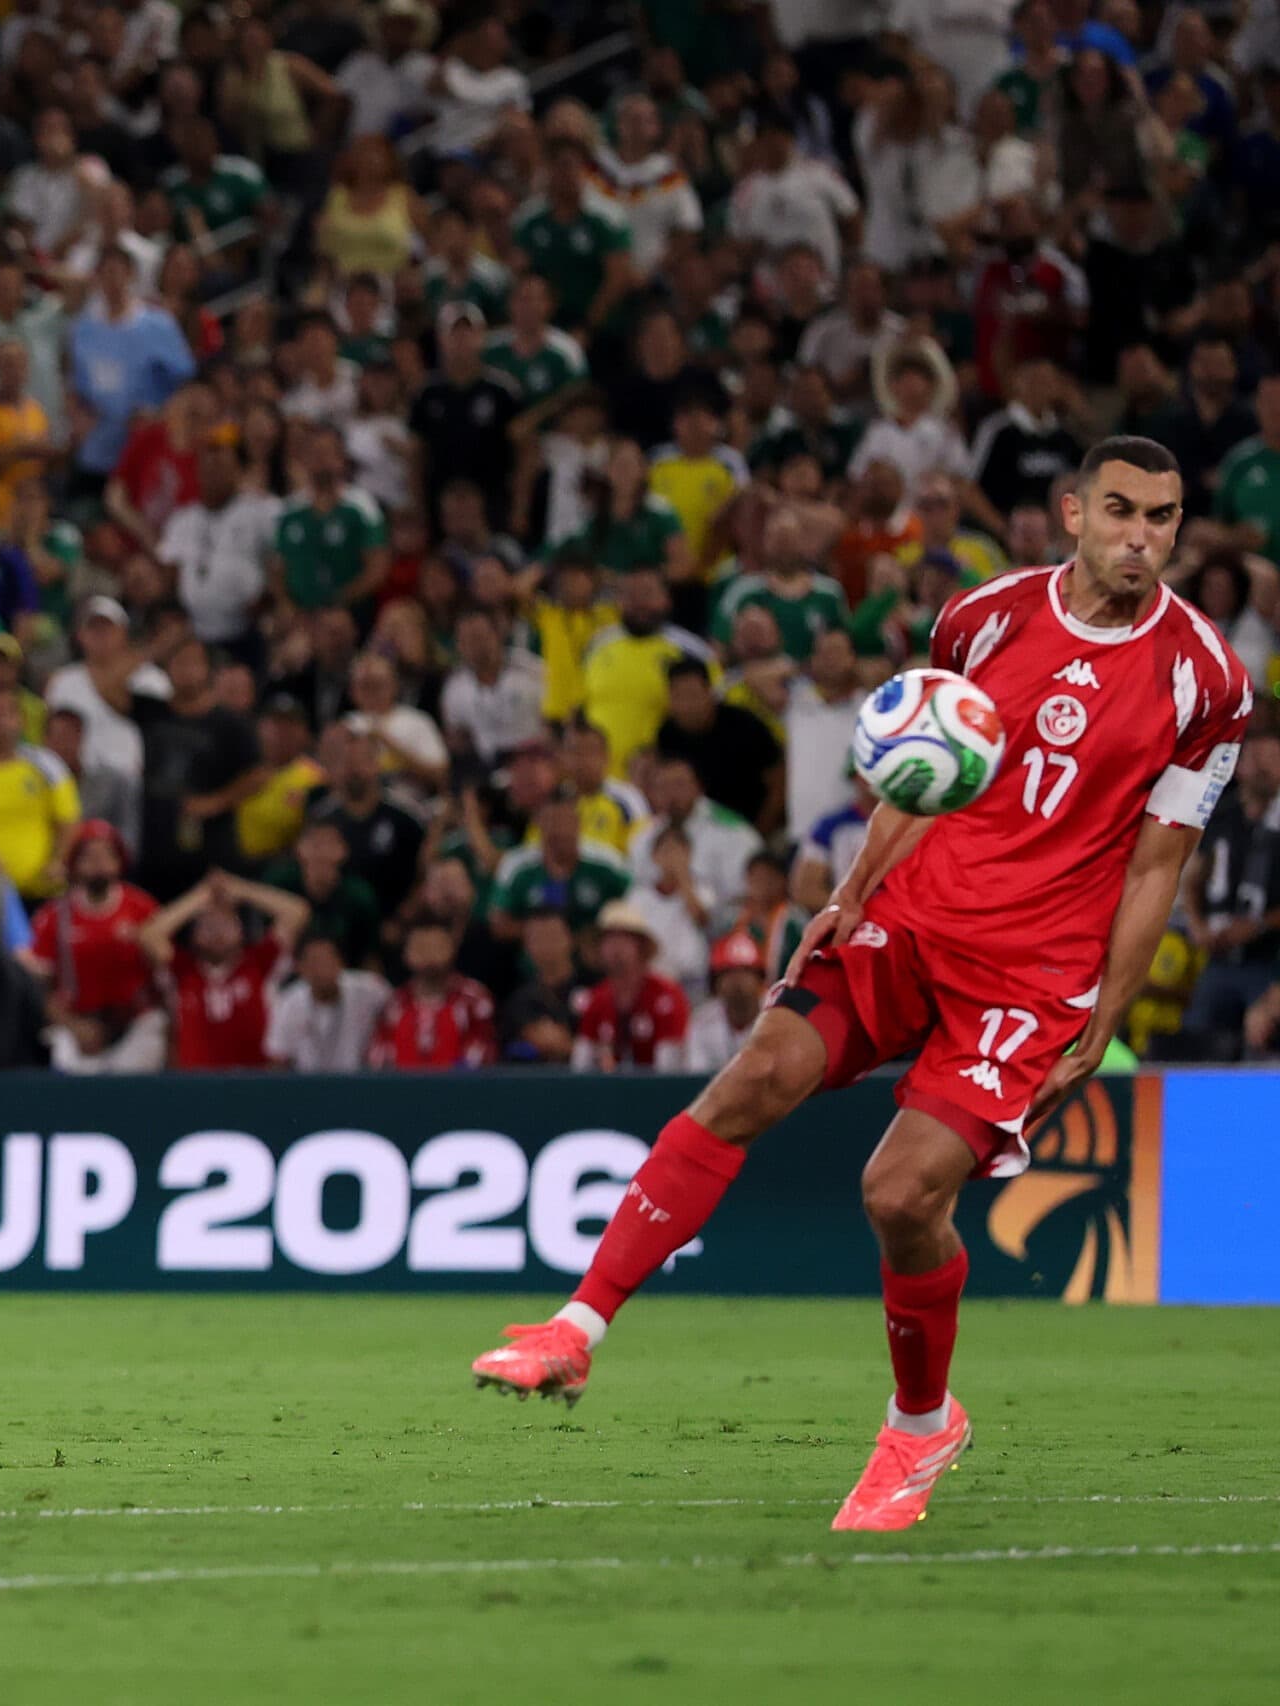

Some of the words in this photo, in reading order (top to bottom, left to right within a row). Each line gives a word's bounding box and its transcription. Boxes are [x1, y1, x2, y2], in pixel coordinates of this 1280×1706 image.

[1022, 747, 1079, 819] 17
[978, 1008, 1039, 1062] 17
[157, 1129, 654, 1274] 2026
